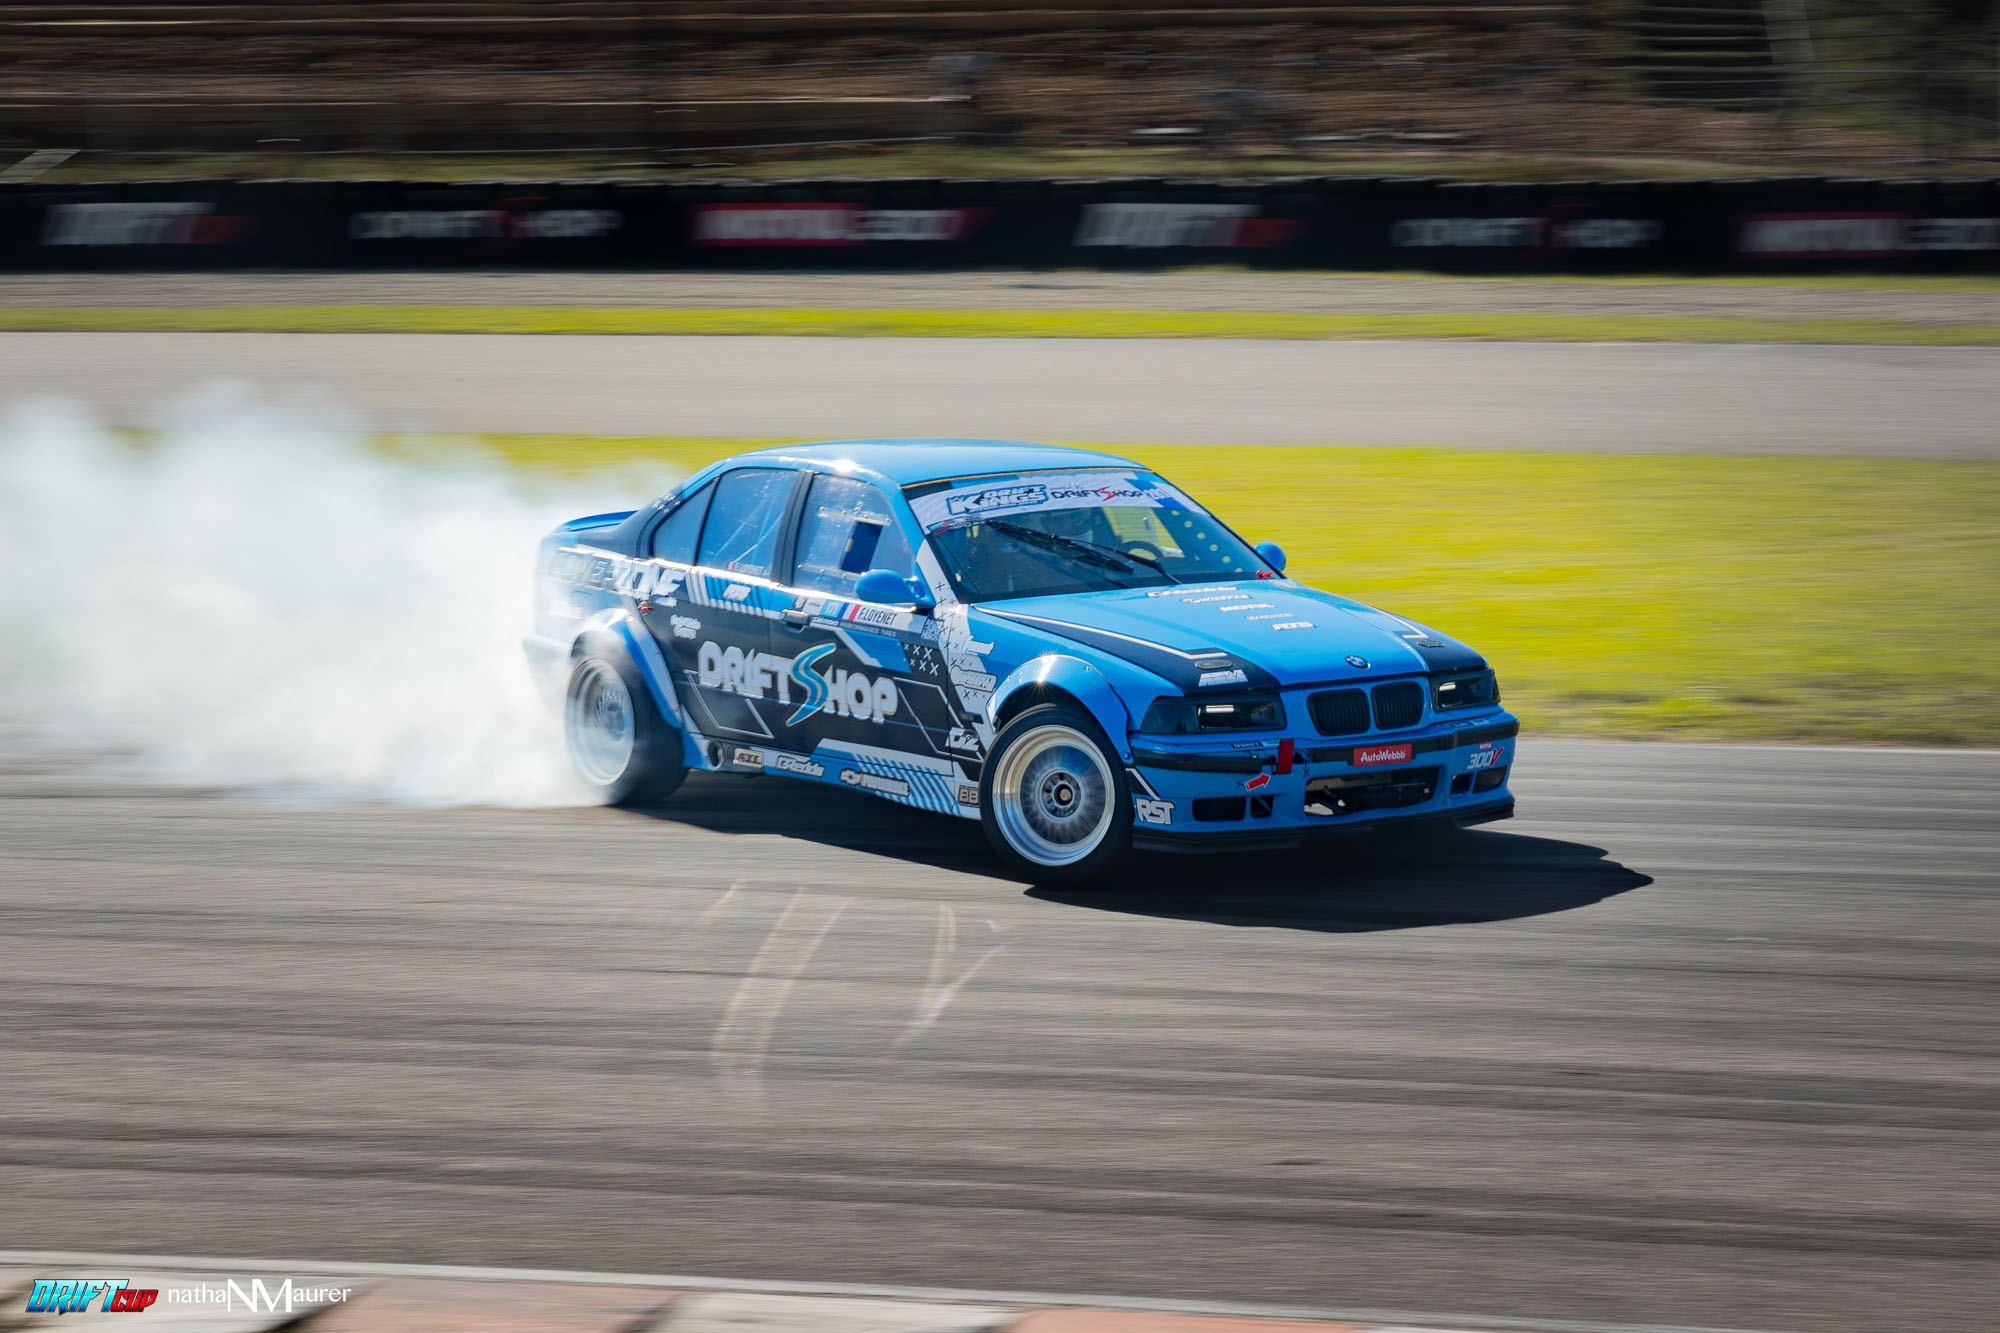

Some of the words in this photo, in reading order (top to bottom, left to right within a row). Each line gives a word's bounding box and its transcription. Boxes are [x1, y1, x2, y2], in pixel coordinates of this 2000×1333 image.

[950, 491, 1042, 513] KINGS
[858, 607, 898, 626] F.LOYENET
[698, 641, 899, 727] DRIFTSHOP
[1360, 749, 1406, 763] AutoWebbb
[1136, 797, 1176, 825] RST
